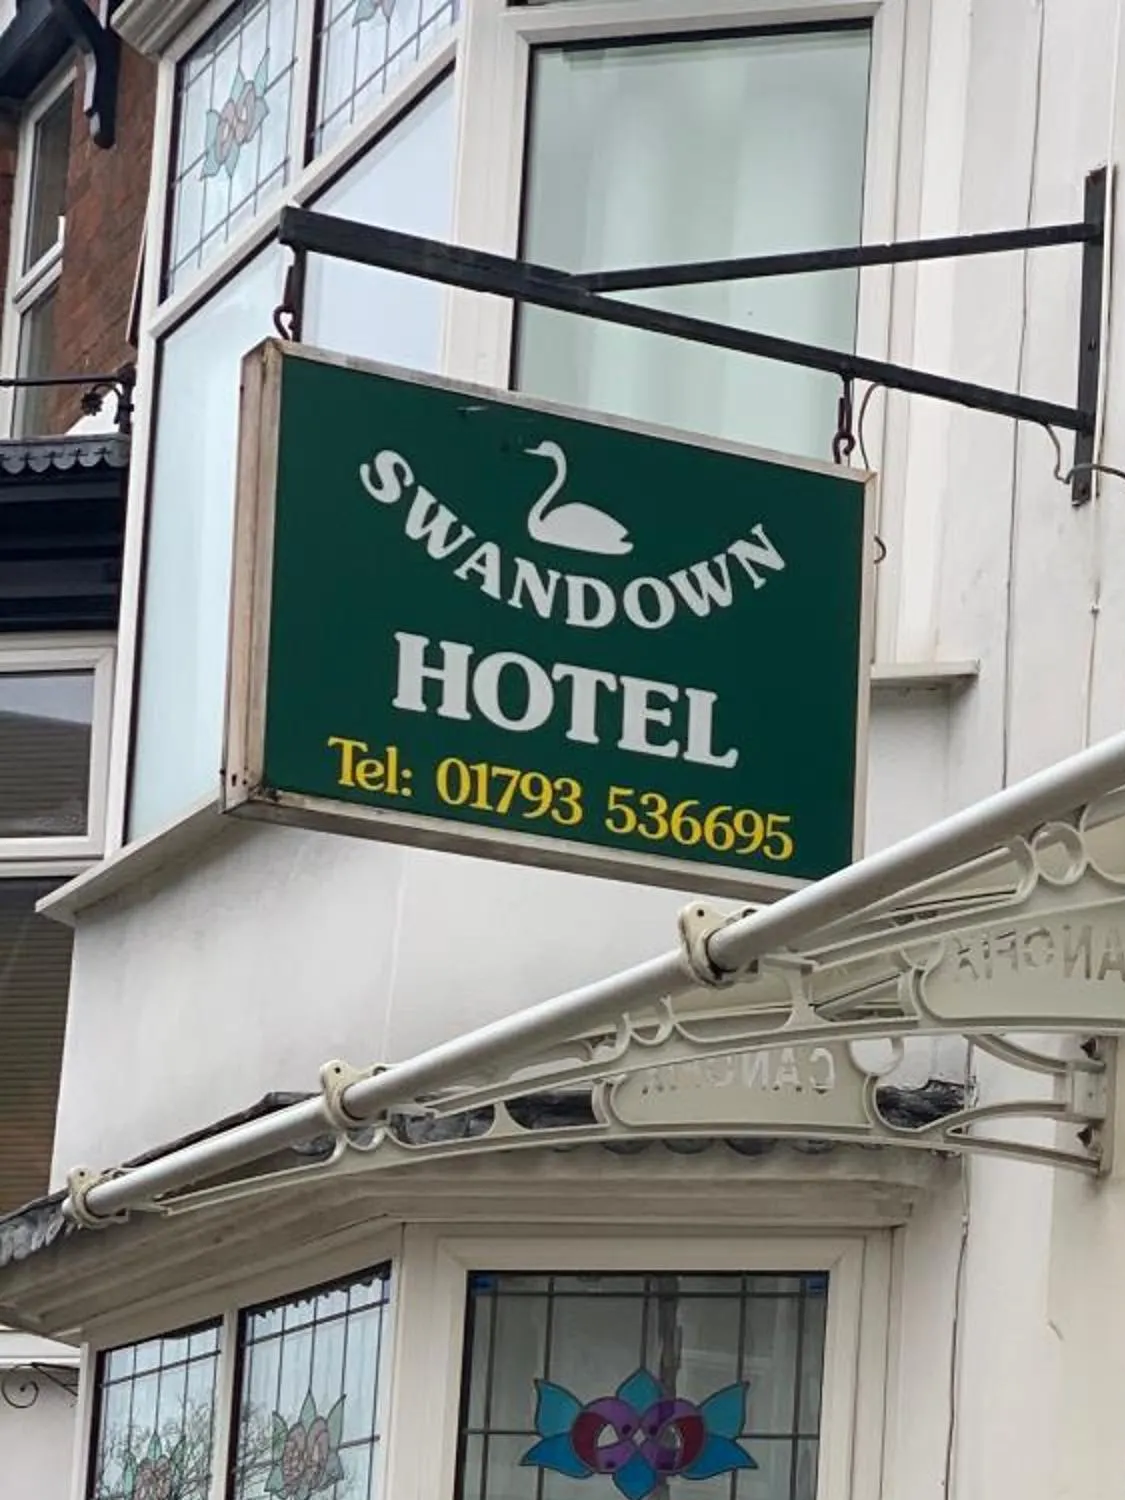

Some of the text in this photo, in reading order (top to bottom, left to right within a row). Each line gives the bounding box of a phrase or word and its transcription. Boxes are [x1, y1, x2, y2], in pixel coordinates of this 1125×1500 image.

[359, 449, 785, 630] SWANDOWN
[391, 631, 739, 769] HOTEL
[327, 736, 794, 861] Tel: 01793 536695
